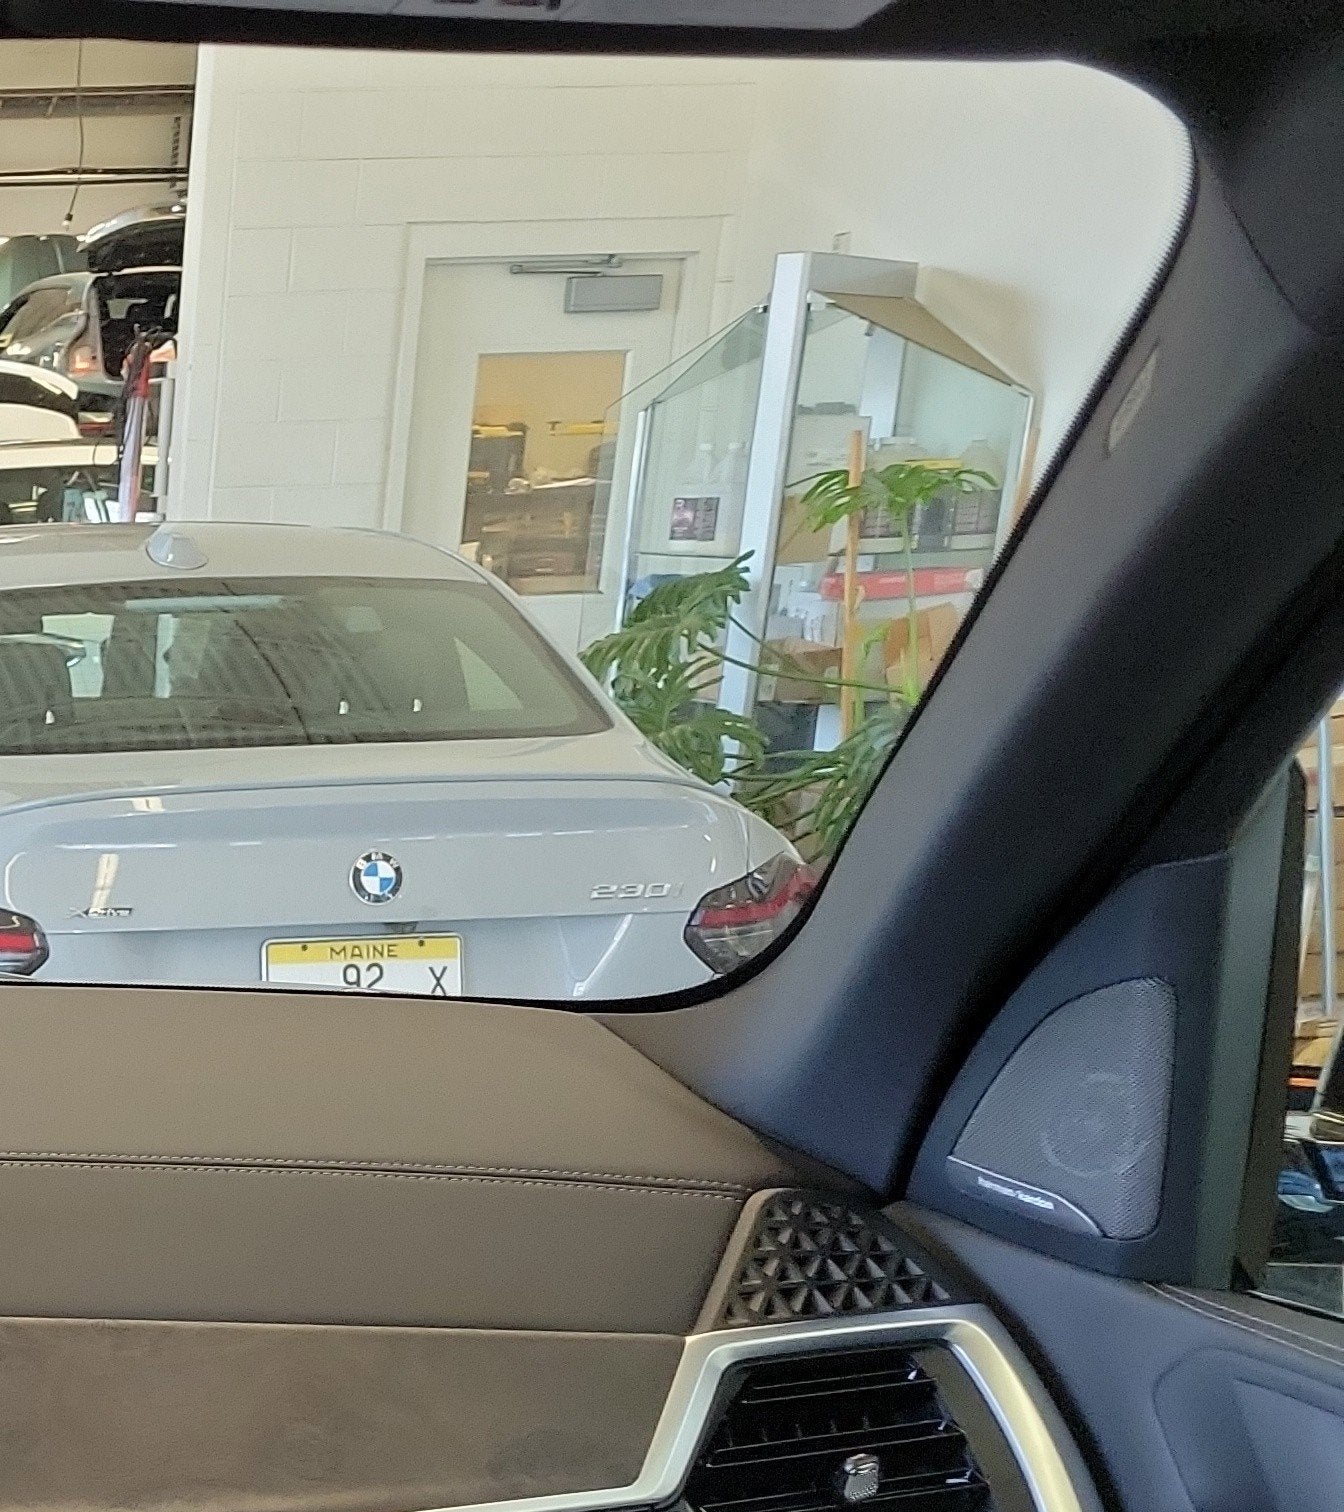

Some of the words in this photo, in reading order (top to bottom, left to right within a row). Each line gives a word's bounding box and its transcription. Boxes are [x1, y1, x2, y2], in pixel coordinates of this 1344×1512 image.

[590, 881, 683, 900] 230i
[329, 943, 398, 960] MAINE
[342, 962, 385, 989] 92
[429, 964, 449, 996] X
